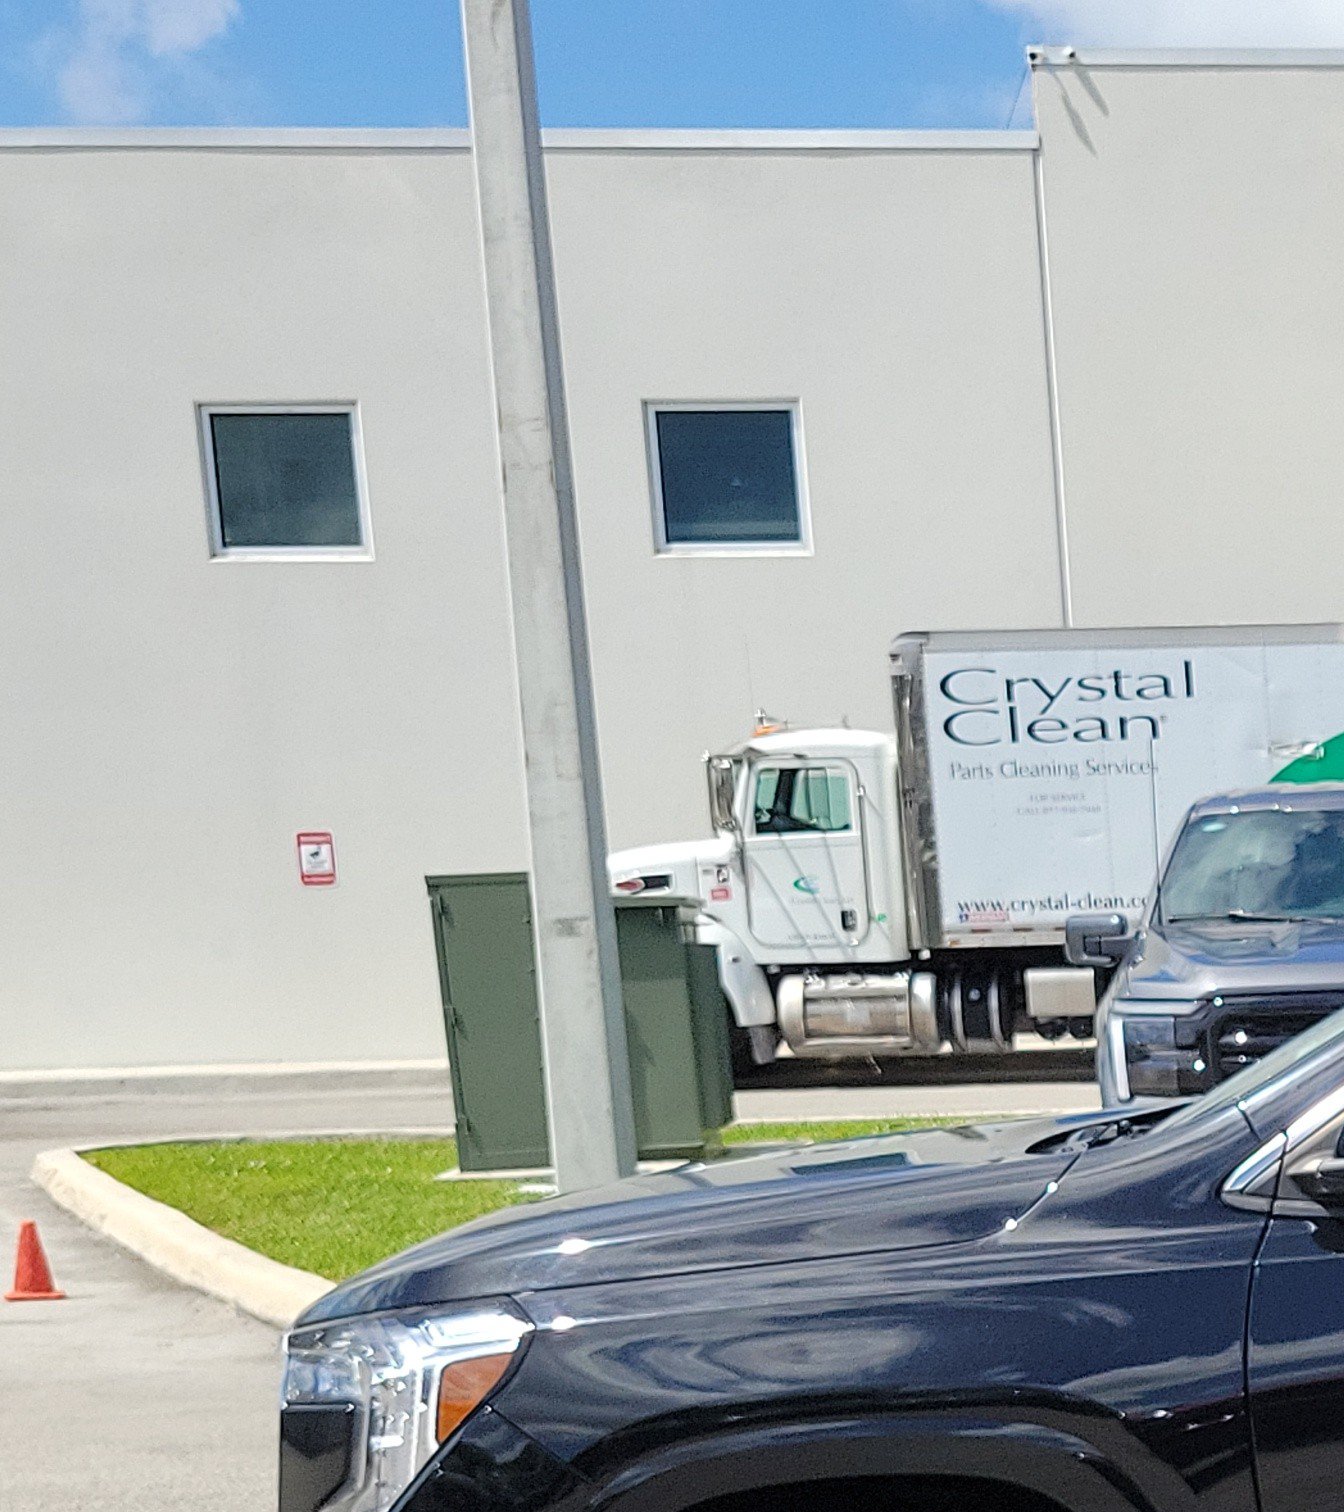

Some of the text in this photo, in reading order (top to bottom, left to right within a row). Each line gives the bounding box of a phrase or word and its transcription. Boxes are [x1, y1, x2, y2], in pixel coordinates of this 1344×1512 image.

[939, 660, 1195, 715] Crystal
[943, 705, 1160, 746] Clean
[950, 760, 994, 780] Parts
[999, 758, 1080, 780] Cleaning
